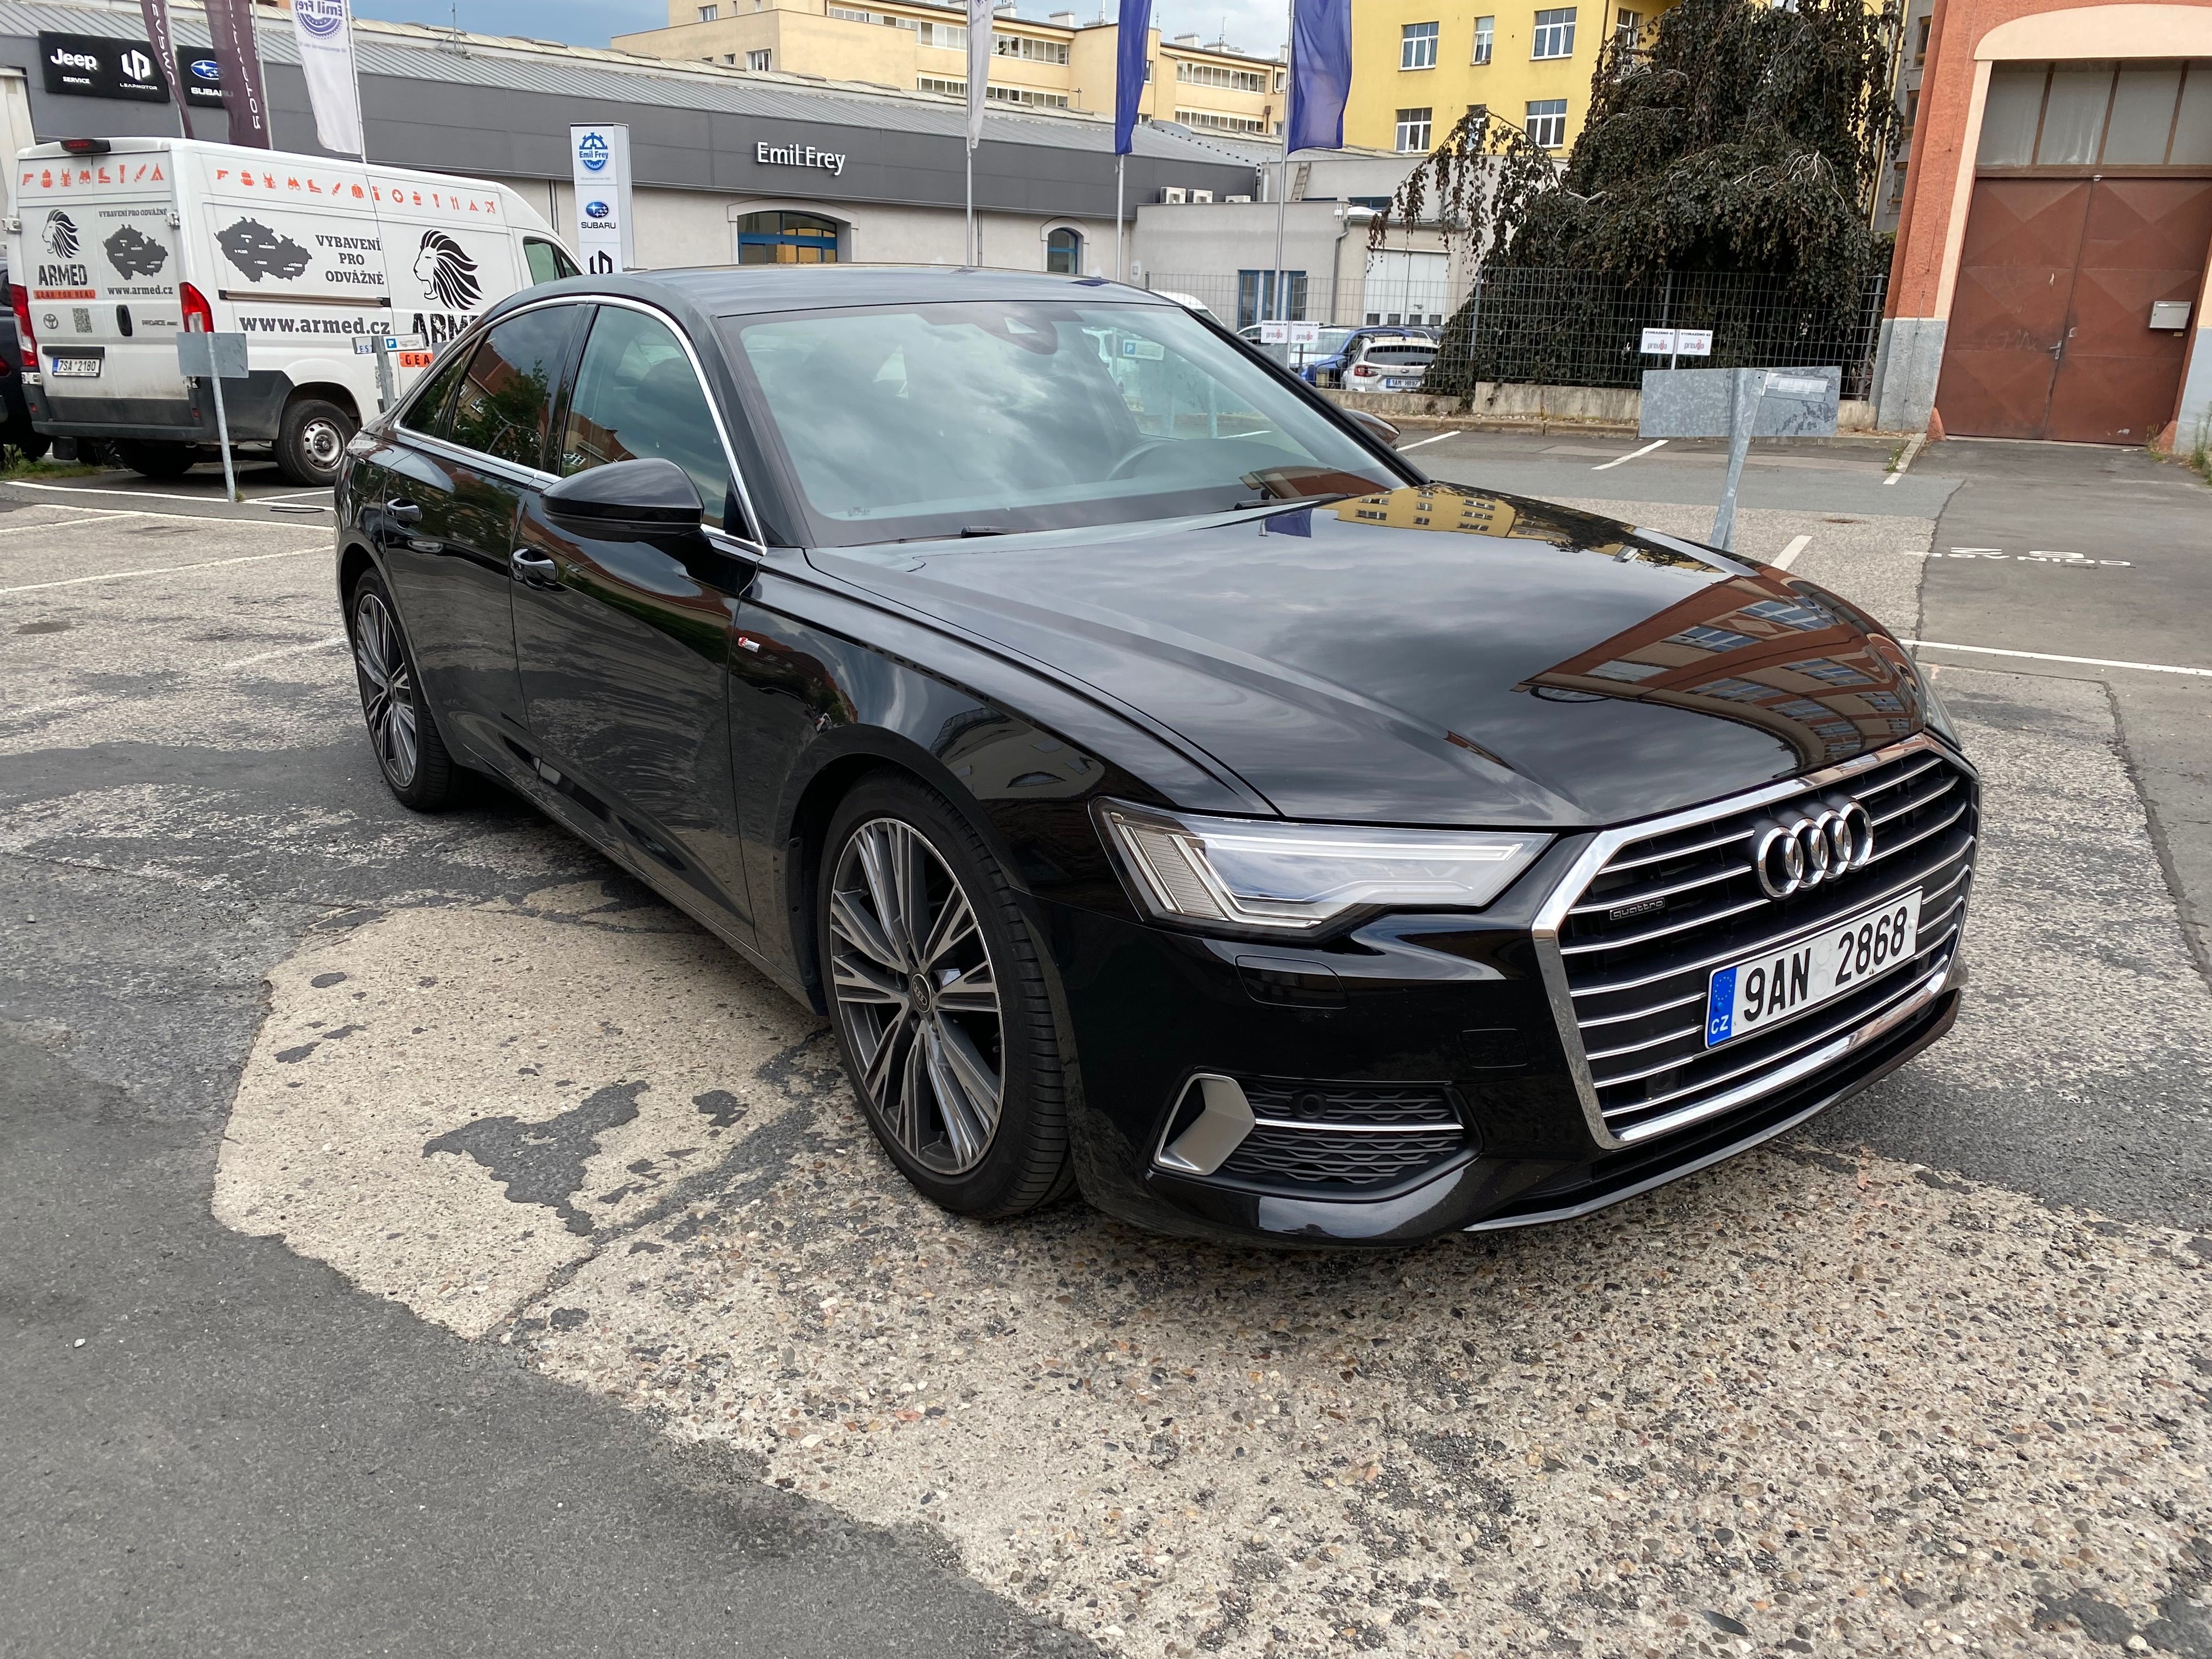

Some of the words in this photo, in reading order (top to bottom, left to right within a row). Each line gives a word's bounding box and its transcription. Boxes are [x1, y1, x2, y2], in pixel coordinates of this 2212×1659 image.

[50, 48, 97, 70] Jeep
[63, 76, 91, 84] SERVICE
[119, 82, 158, 91] LEAPMOTOR
[595, 150, 609, 160] Frey
[757, 141, 799, 166] Emil
[805, 145, 846, 176] Frey
[98, 208, 128, 217] VYBAVENÍ
[315, 234, 382, 251] VYBAVENÍ
[338, 252, 365, 265] PRO
[38, 264, 87, 286] ARMED
[325, 269, 384, 285] ODVÁŽNÉ
[107, 285, 173, 295] www.armed.cz
[239, 317, 391, 335] www.armed.cz
[413, 313, 480, 347] ARM
[59, 360, 72, 371] 7SA
[77, 360, 96, 371] 2180
[405, 354, 431, 365] GEA
[1613, 900, 1663, 918] quattro
[1743, 946, 1811, 1023] 9AN
[1835, 906, 1908, 986] 2868
[1710, 1016, 1729, 1036] CZ
